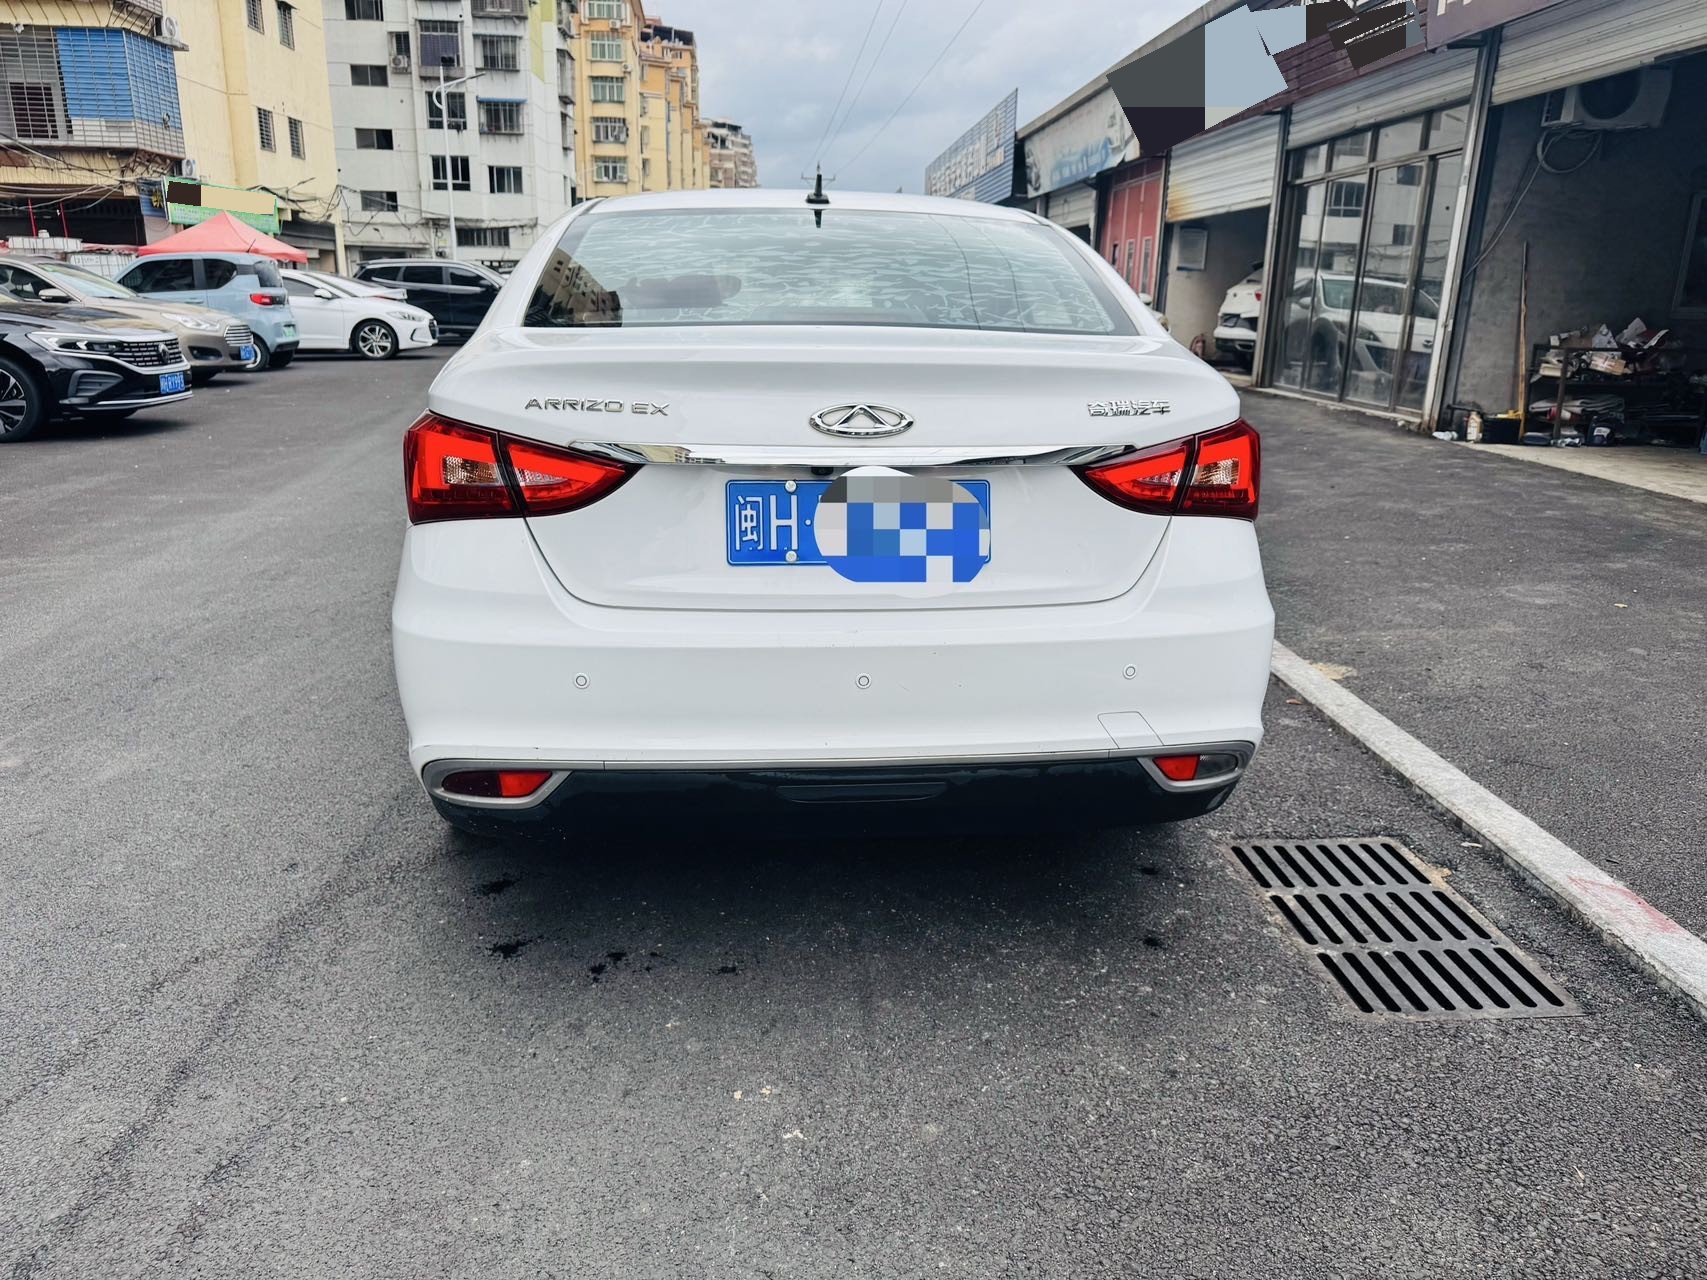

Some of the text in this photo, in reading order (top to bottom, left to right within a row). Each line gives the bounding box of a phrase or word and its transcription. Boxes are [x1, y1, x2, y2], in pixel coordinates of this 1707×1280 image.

[524, 398, 671, 416] ARRIZO EX
[1087, 400, 1171, 417] 奇瑞汽车
